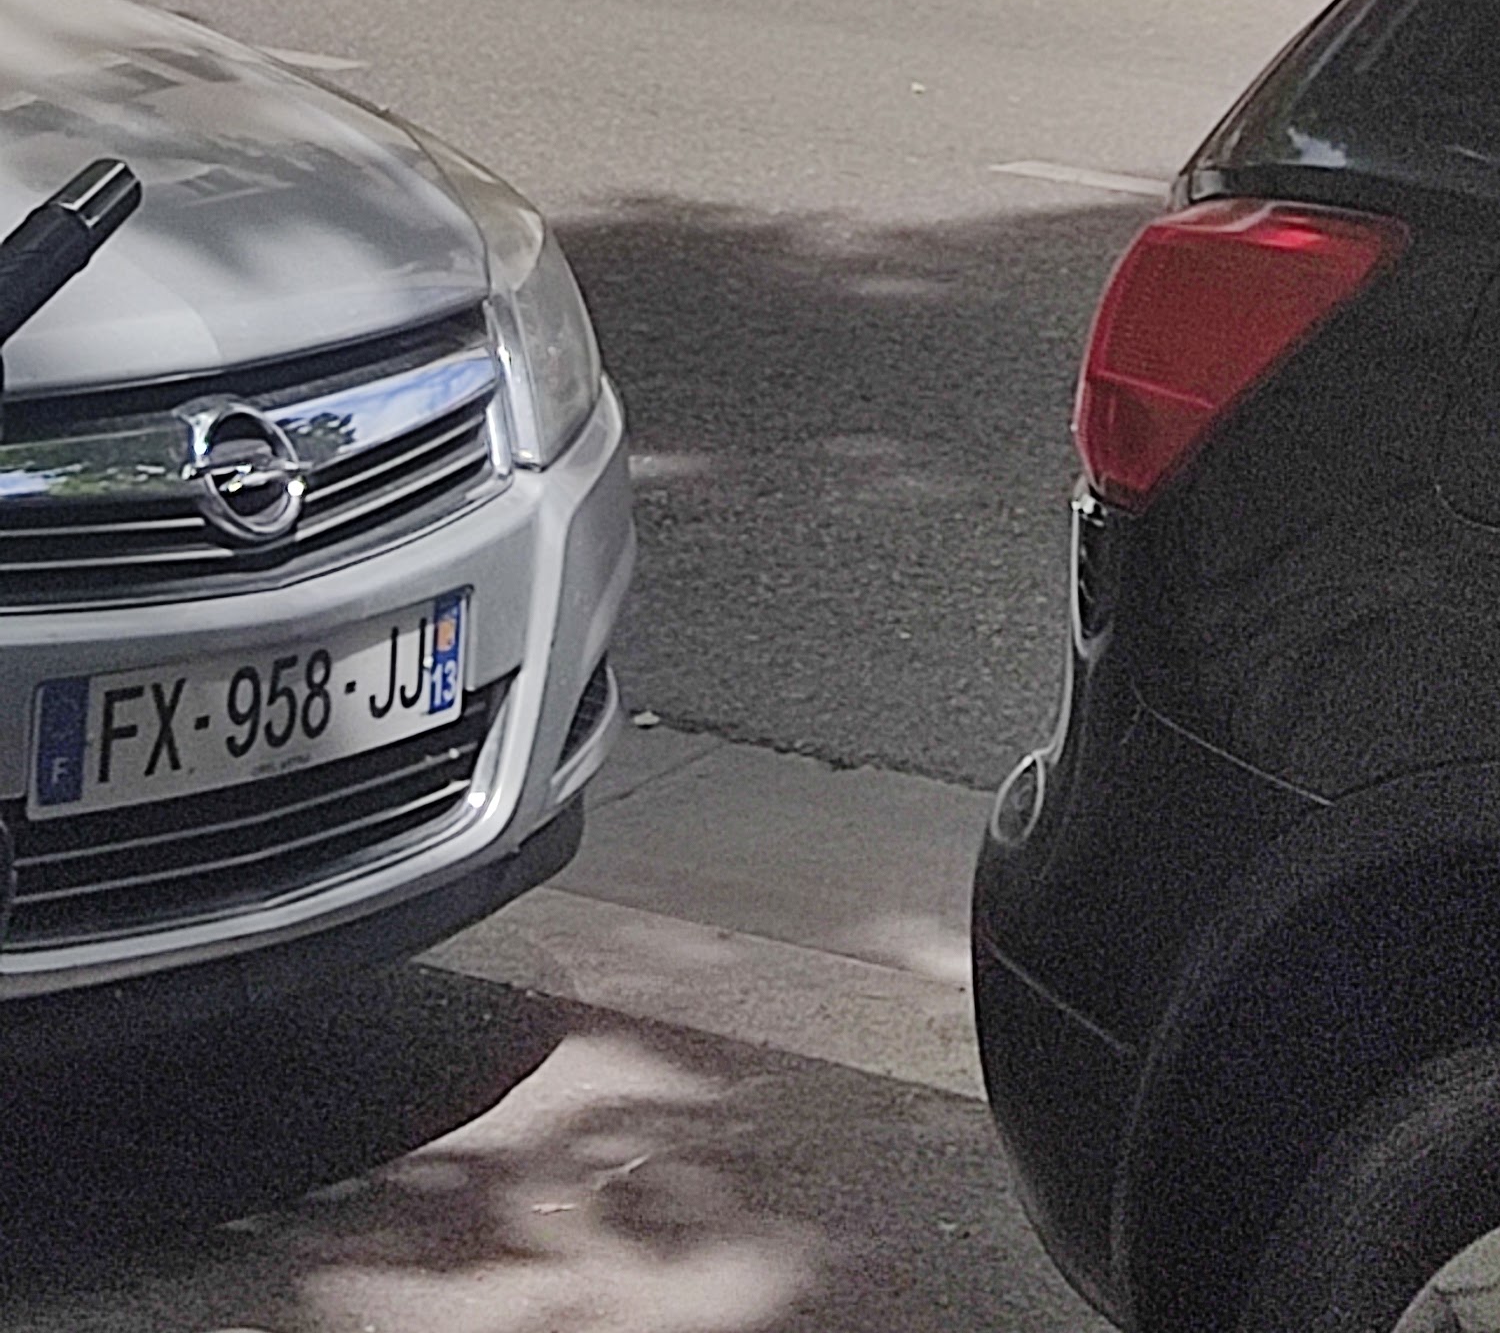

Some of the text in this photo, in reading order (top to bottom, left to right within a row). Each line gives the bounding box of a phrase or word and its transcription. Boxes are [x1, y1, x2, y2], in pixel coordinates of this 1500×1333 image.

[96, 617, 428, 785] FX-958-JJ
[429, 659, 457, 709] 13
[50, 756, 68, 785] F
